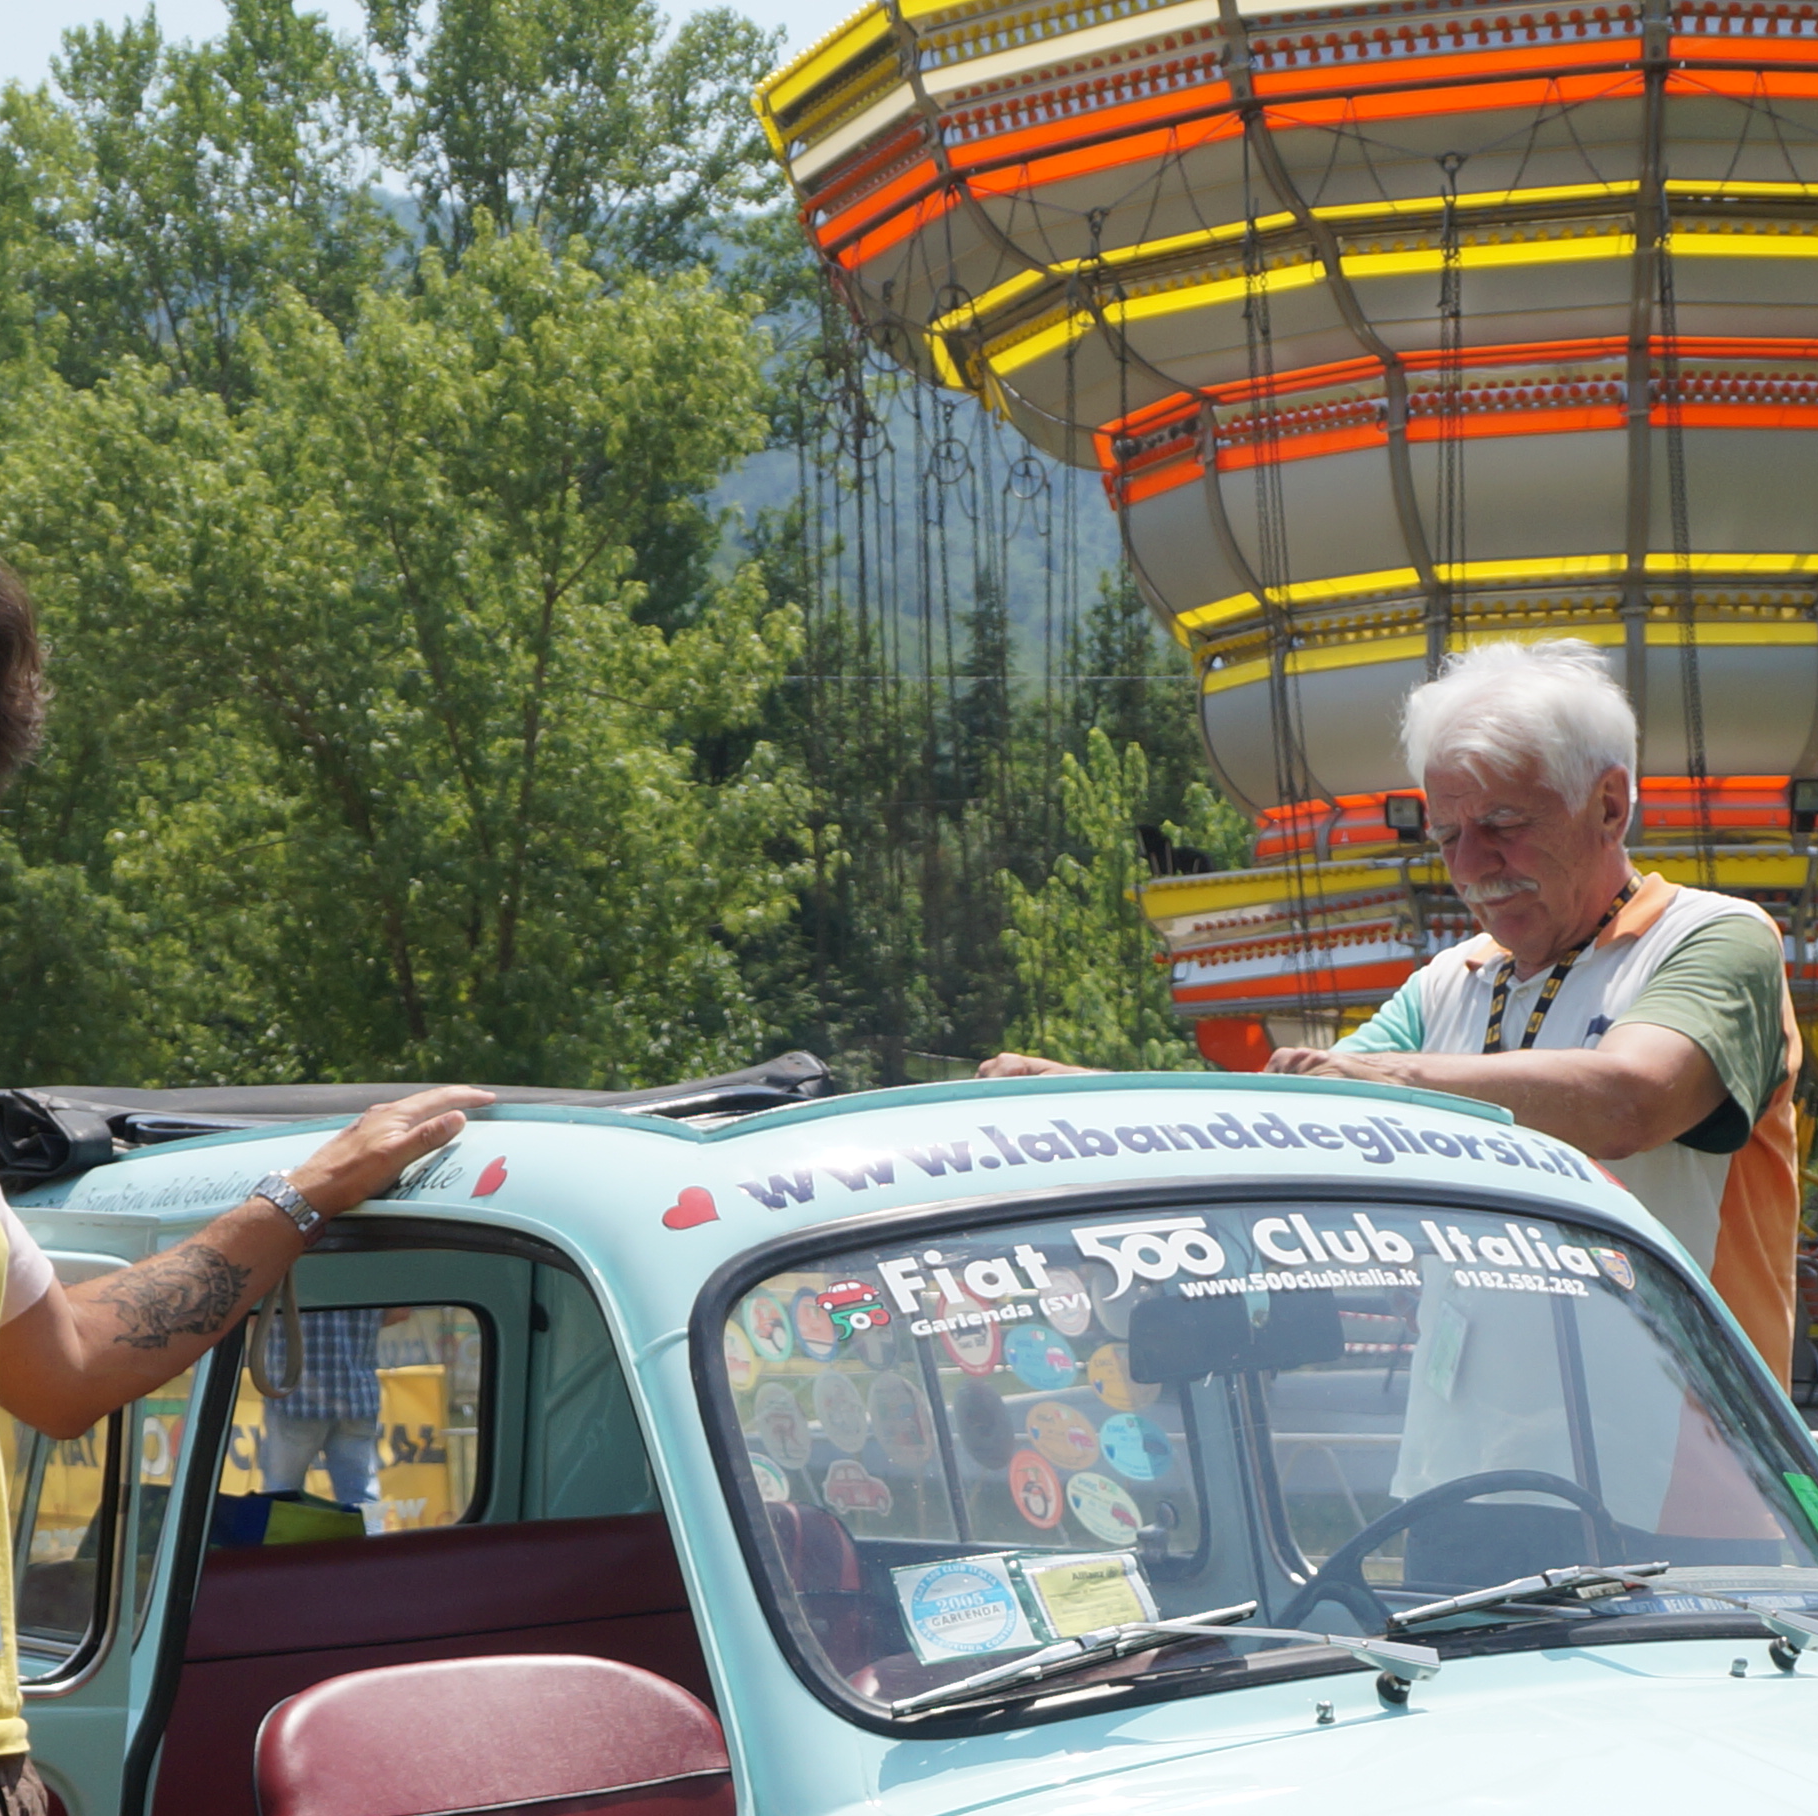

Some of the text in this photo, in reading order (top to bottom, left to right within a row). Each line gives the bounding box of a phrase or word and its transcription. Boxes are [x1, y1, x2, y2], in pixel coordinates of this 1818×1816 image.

[736, 1110, 1594, 1212] www.labanddegliorsi.it
[878, 1213, 1600, 1315] Fiat 500 Club Italia
[1178, 1268, 1421, 1299] www.500clubitalia.it
[1454, 1269, 1590, 1297] 0182.582.282
[828, 1303, 891, 1342] 500
[910, 1290, 1093, 1337] Garlenda (SV)
[941, 1563, 967, 1574] CLUB
[969, 1565, 998, 1587] ITALIA
[1071, 1569, 1104, 1581] Allianz
[931, 1604, 1002, 1627] GARLENDA
[935, 1591, 986, 1613] 2005
